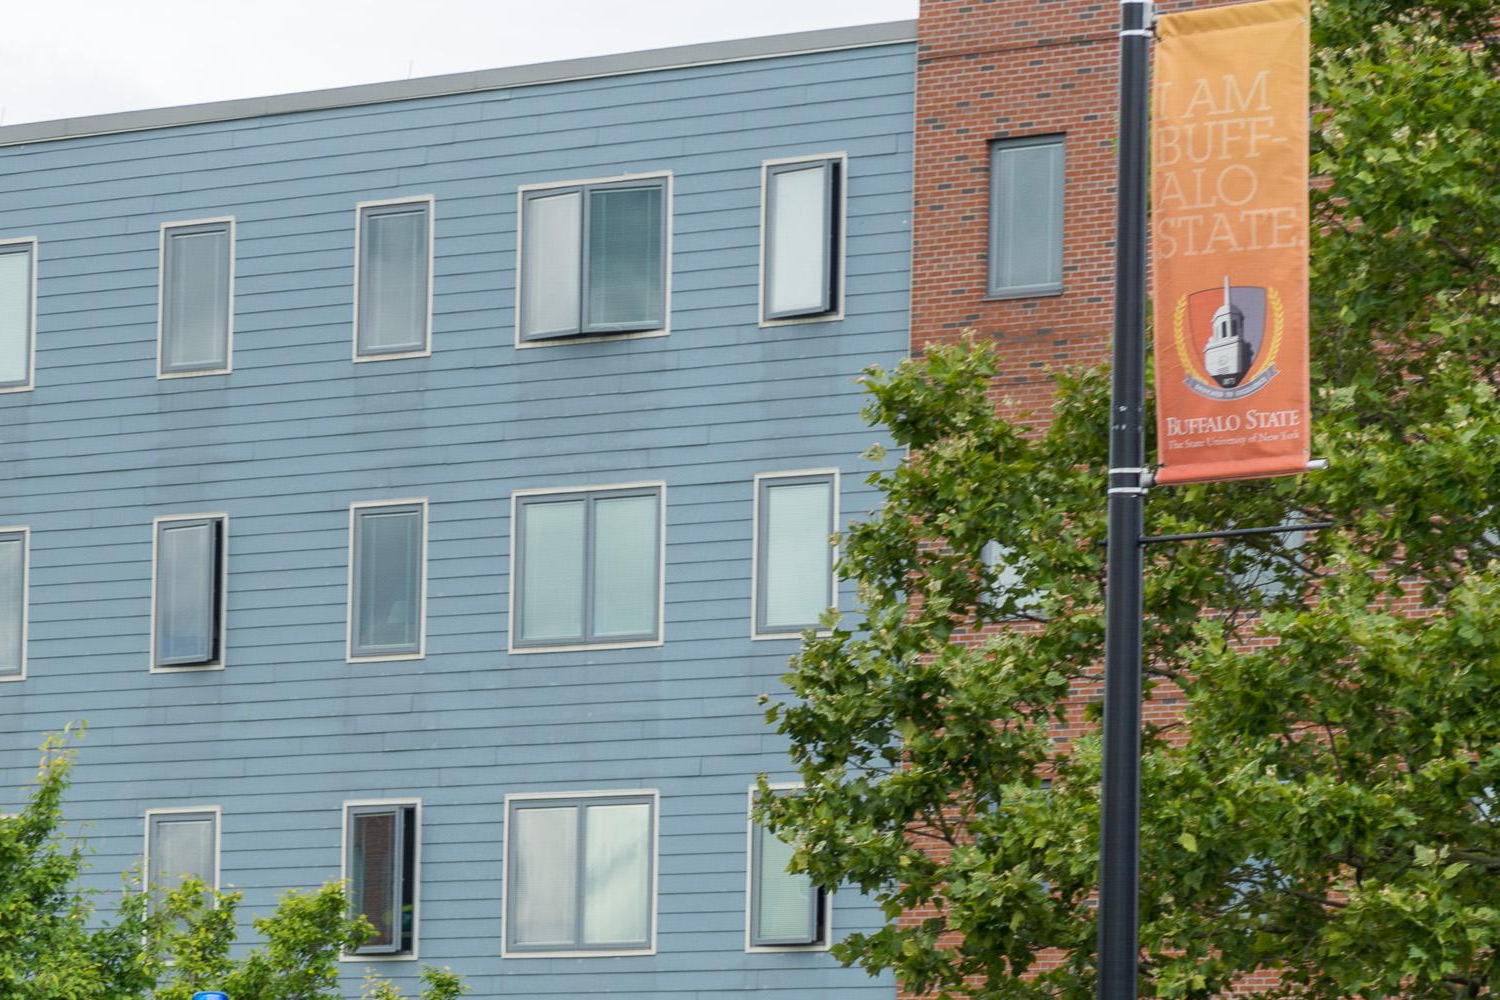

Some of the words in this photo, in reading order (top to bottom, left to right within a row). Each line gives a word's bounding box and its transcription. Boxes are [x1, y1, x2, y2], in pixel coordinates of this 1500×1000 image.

[1155, 81, 1173, 121] I
[1181, 69, 1272, 119] AM
[1155, 115, 1288, 169] BUFF-
[1154, 163, 1258, 214] ALO
[1166, 414, 1241, 437] BUFFALO
[1245, 408, 1301, 430] STATE
